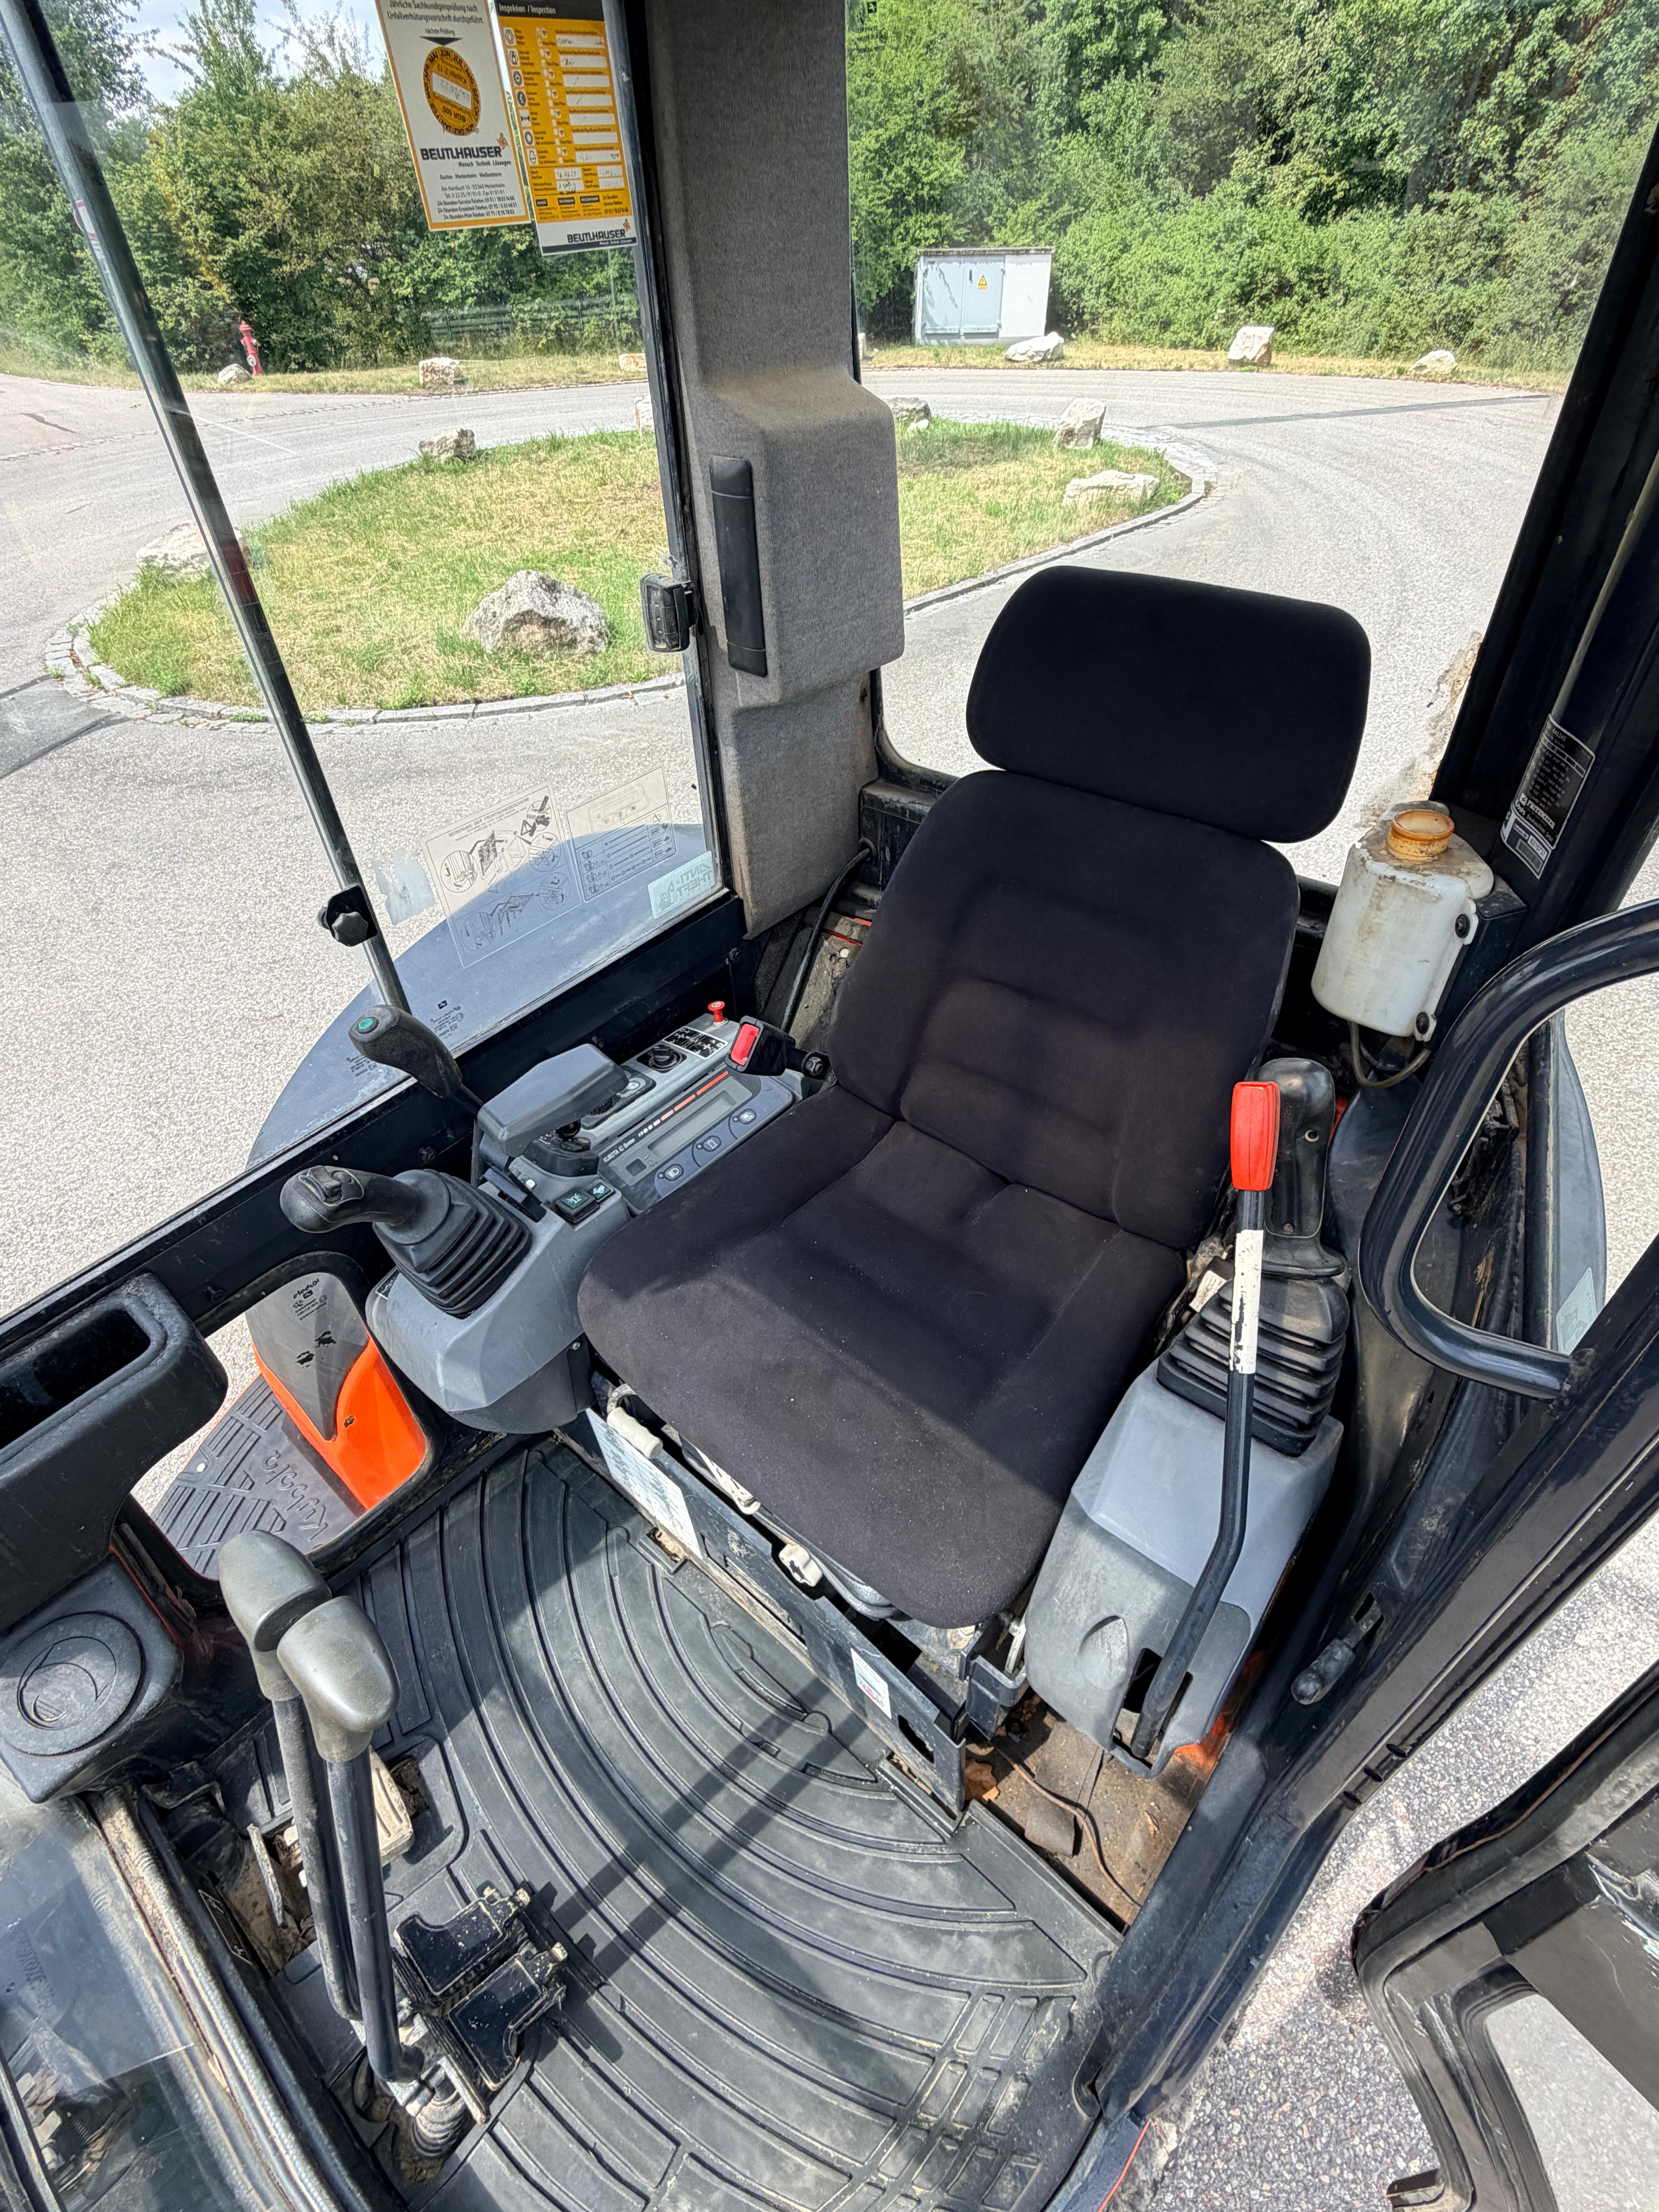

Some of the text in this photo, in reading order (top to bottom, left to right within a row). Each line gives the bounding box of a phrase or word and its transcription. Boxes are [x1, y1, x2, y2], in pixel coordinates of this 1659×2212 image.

[499, 3, 526, 13] Inspektion
[531, 5, 556, 15] Inspection
[420, 146, 502, 160] BEUTLHAUSER
[567, 229, 626, 243] BEUTLHAUSER
[448, 824, 473, 837] BEDIENUNG
[603, 1149, 620, 1163] KUBOTA
[262, 1448, 329, 1541] Kubota
